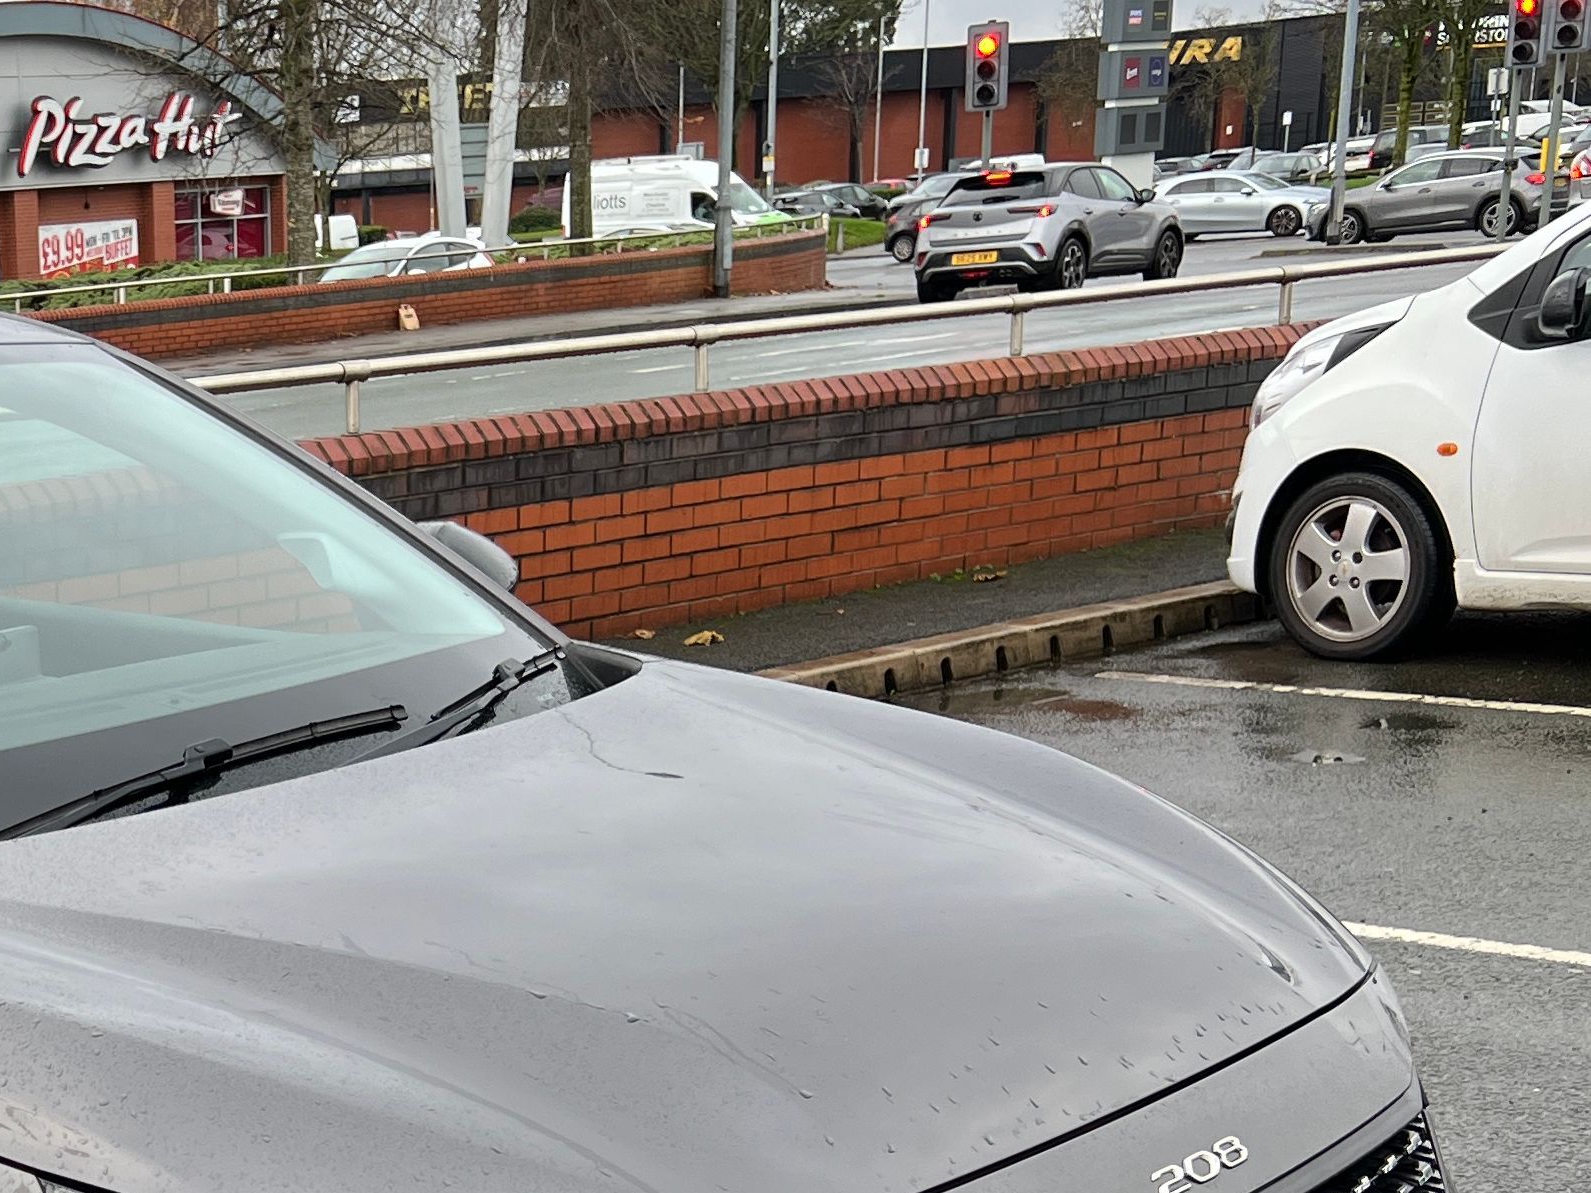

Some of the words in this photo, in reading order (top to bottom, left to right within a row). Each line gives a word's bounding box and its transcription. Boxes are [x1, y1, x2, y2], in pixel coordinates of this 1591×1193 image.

[18, 95, 149, 178] Pizza
[151, 91, 242, 163] Hut
[593, 194, 627, 210] liotts
[42, 228, 84, 270] £9.99
